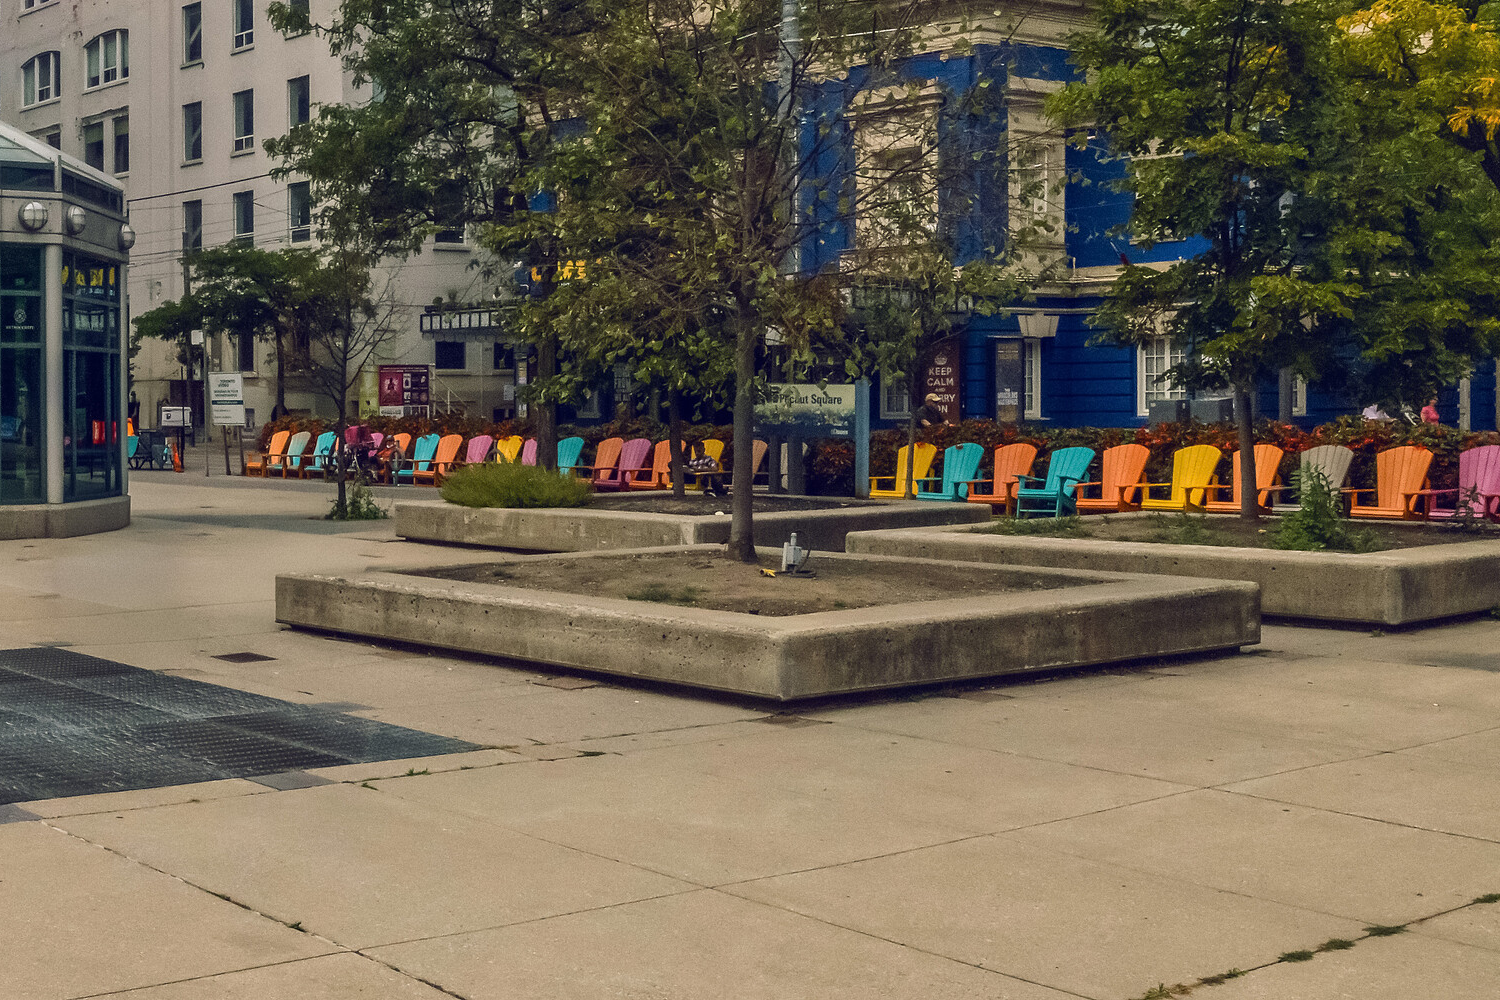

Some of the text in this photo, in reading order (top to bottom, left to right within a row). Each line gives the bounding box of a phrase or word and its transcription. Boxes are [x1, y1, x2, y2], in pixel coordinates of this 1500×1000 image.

[928, 366, 952, 376] KEEP
[926, 377, 954, 386] CALM
[811, 393, 843, 407] Square
